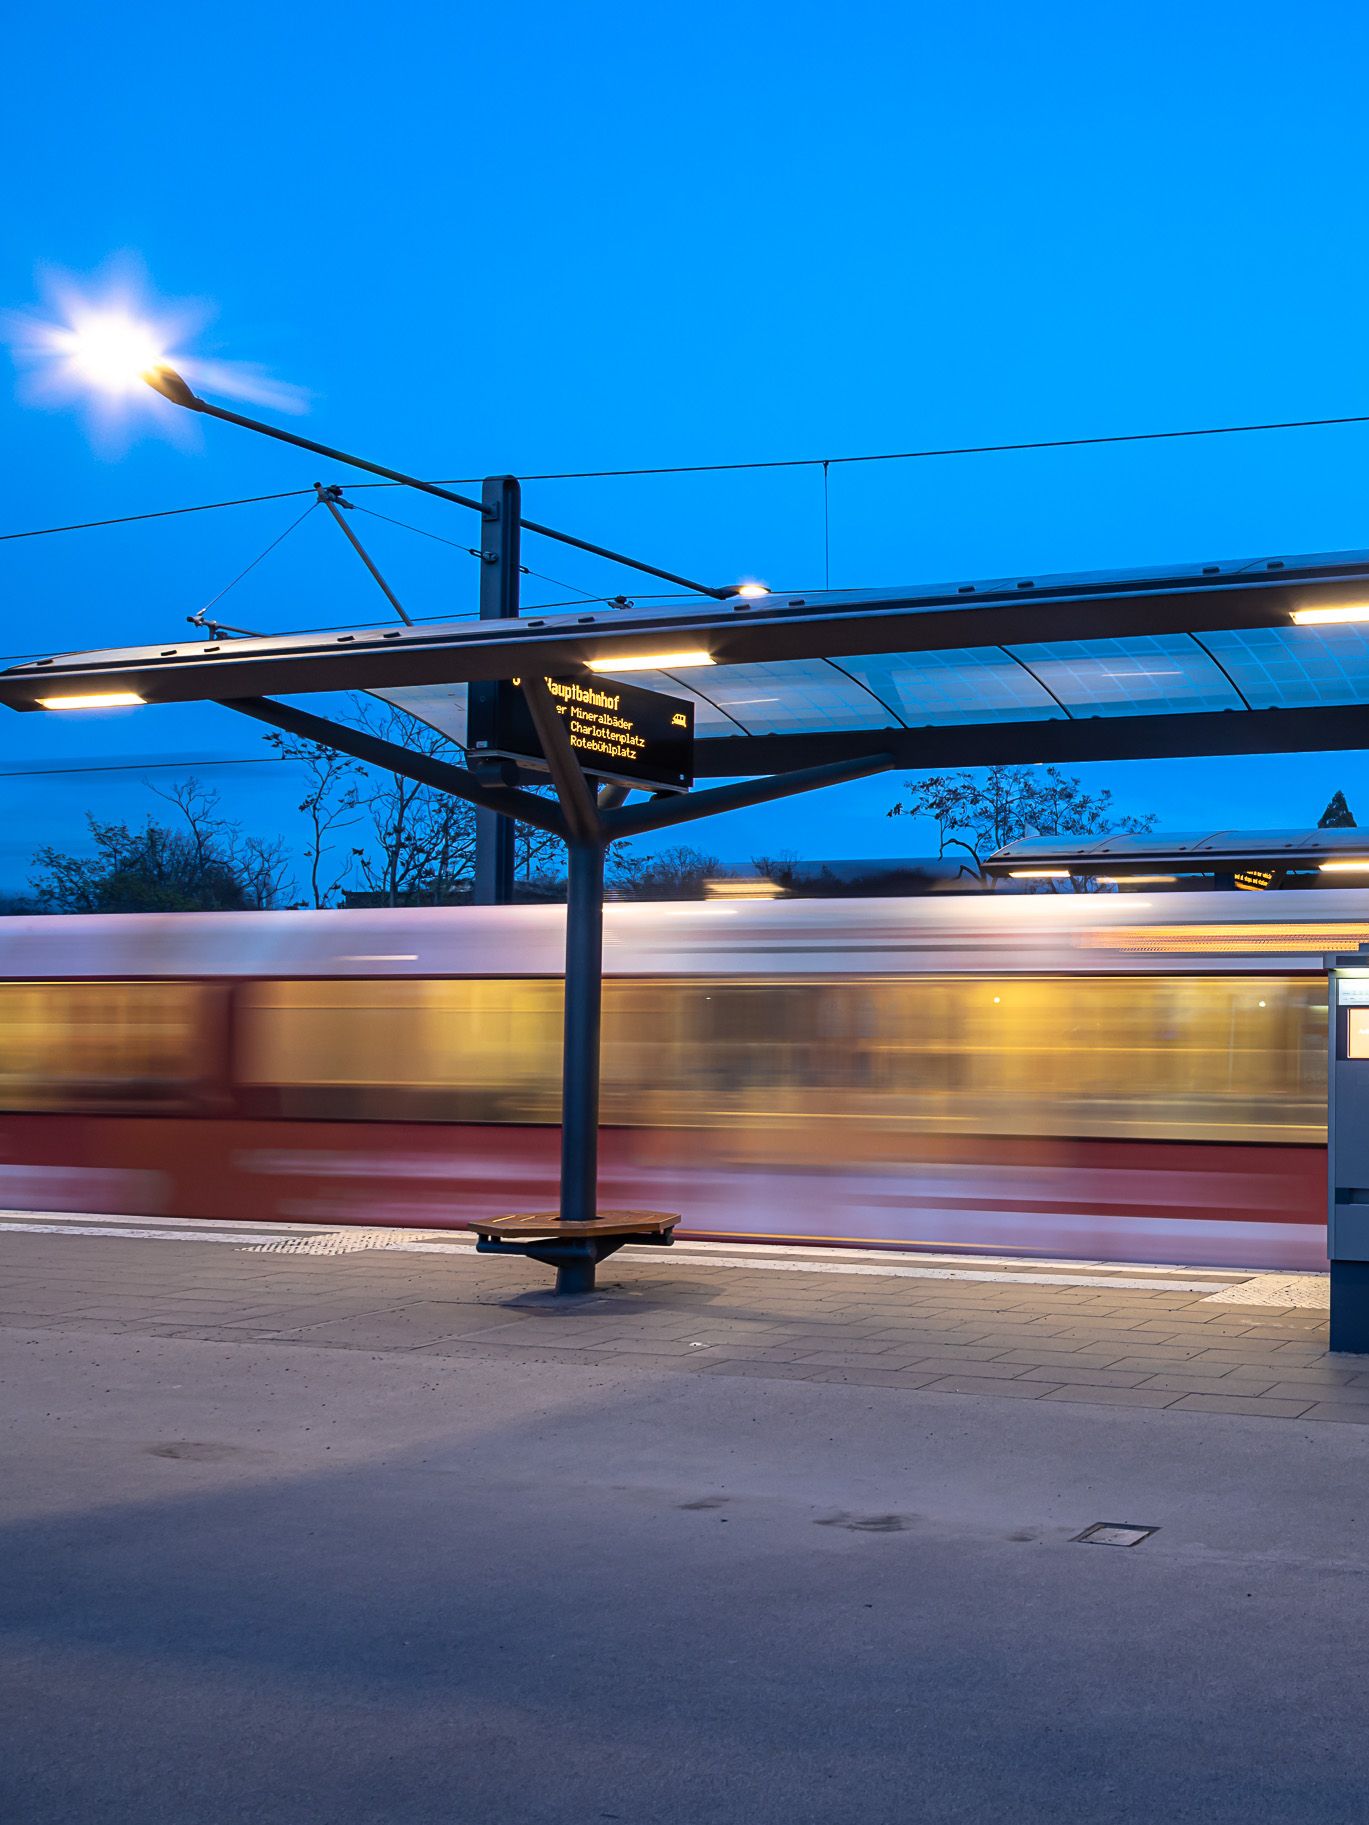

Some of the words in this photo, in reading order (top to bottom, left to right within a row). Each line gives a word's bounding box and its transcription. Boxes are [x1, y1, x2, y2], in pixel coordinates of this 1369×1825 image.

[570, 706, 634, 730] Mineralbäder
[570, 720, 645, 747] Charlottenplatz
[570, 735, 637, 759] Rotebühlplatz
